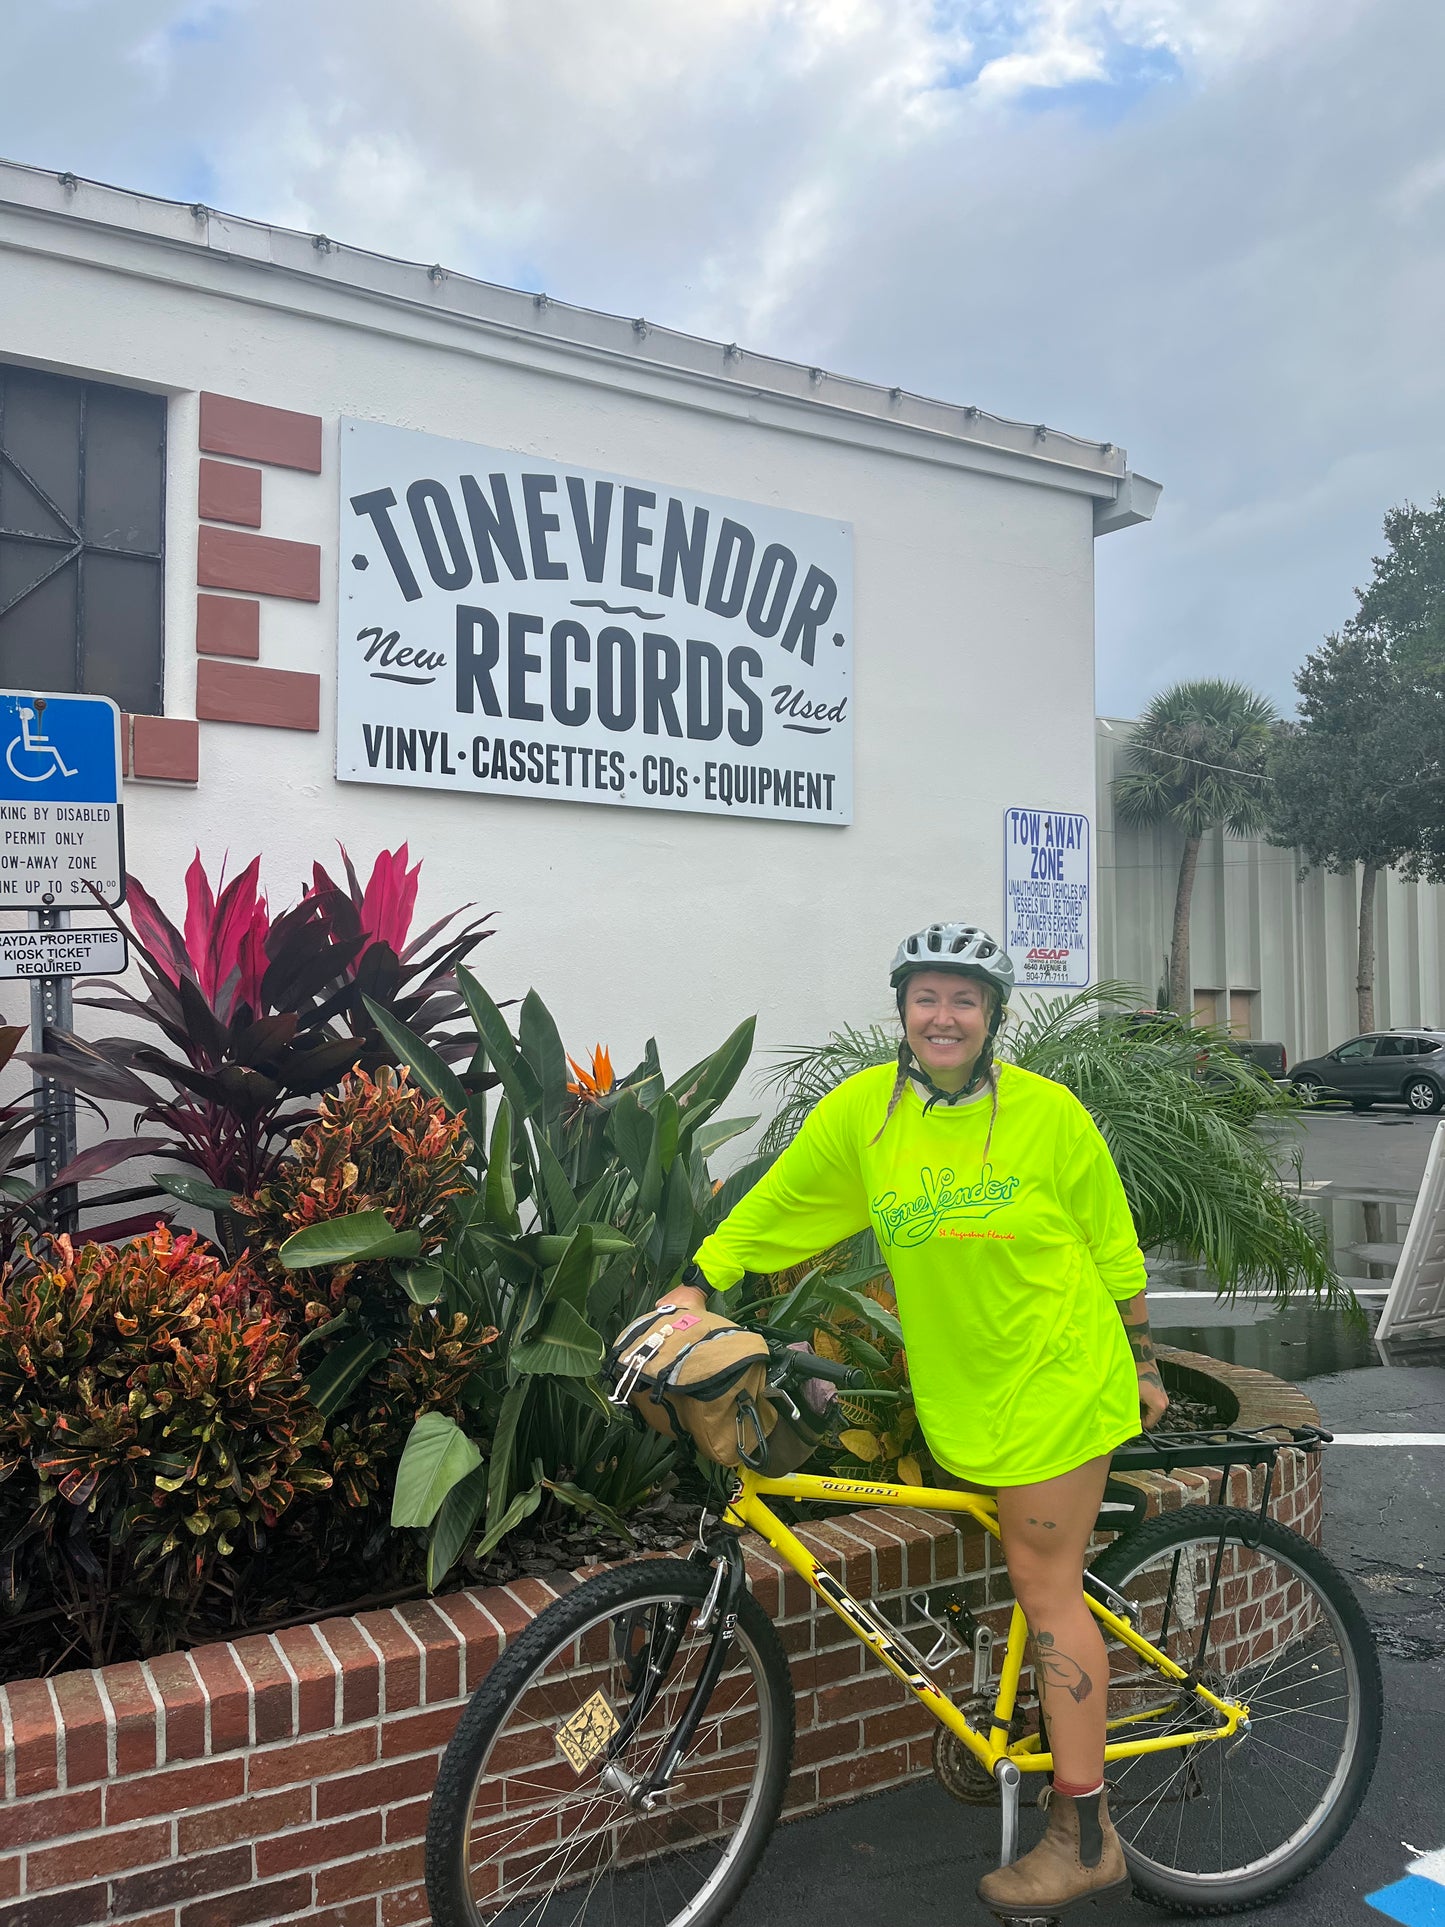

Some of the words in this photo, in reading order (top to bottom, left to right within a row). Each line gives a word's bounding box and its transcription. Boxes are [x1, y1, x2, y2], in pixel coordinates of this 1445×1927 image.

[350, 473, 838, 667] TONEVENDOR
[357, 626, 447, 669] New
[456, 604, 763, 747] RECORDS
[771, 684, 848, 723] Used
[362, 723, 456, 775] VINYL
[472, 735, 625, 792] CASSETTES
[642, 755, 688, 798] CDs
[704, 762, 836, 811] EQUIPMENT
[34, 807, 49, 820] BY
[57, 808, 111, 822] DISABLED
[5, 831, 46, 845] PERMIT
[55, 832, 84, 845] ONLY
[1011, 811, 1041, 846] TOW
[1045, 815, 1083, 849] AWAY
[68, 856, 97, 870] ZONE
[1031, 846, 1064, 881] ZONE
[25, 880, 40, 894] UP
[48, 880, 63, 894] TO
[1008, 879, 1051, 898] UNAUTHORIZED
[1051, 882, 1078, 900] VEHICLES
[1078, 884, 1087, 900] OR
[1013, 896, 1039, 914] VESSELS
[1039, 898, 1053, 915] WILL
[1053, 899, 1062, 916] BE
[1062, 900, 1083, 917] TOWED
[1017, 914, 1025, 929] AT
[1053, 916, 1079, 933] EXPENSE
[40, 933, 118, 946] PROPERTIES
[1031, 931, 1036, 947] A
[1036, 931, 1048, 948] DAY
[1053, 933, 1069, 949] DAYS
[1069, 934, 1074, 949] A
[4, 948, 44, 961] KIOSK
[47, 947, 92, 958] TICKET
[1026, 948, 1070, 960] ASAP
[16, 961, 82, 974] REQUIRED
[1023, 963, 1038, 971] 4640
[1038, 964, 1061, 972] AVENUE
[950, 1228, 985, 1241] Augustine
[987, 1230, 1016, 1240] Florida
[823, 1483, 894, 1496] OUTPOST
